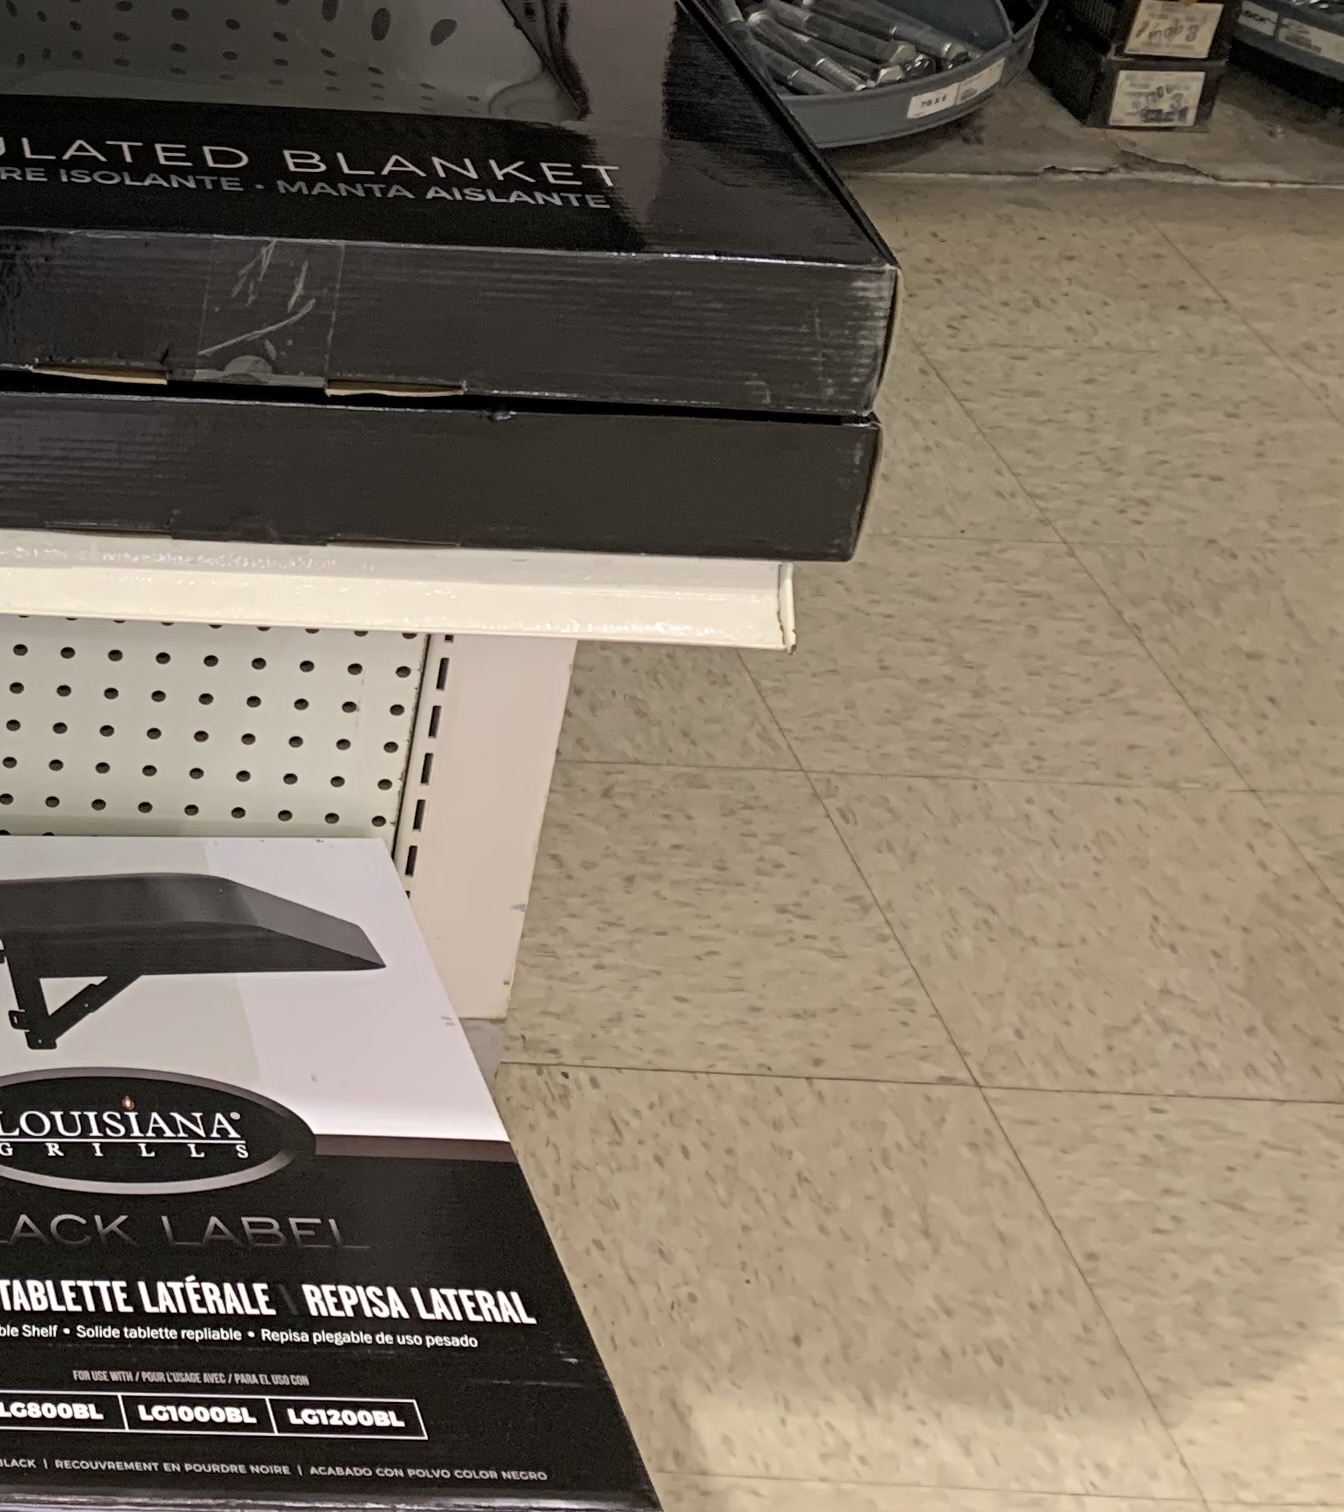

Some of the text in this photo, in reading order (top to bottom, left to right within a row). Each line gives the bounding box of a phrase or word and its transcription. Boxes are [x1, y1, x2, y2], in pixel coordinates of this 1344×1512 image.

[282, 149, 619, 187] BLANKET
[161, 1215, 370, 1249] LABEL
[138, 1275, 276, 1315] LATÉRALE
[302, 1284, 409, 1319] REPISA
[411, 1287, 537, 1324] LATERAL
[22, 1324, 57, 1337] Shelf
[138, 1405, 257, 1424] LG1000BL
[287, 1408, 405, 1427] LG1200BL
